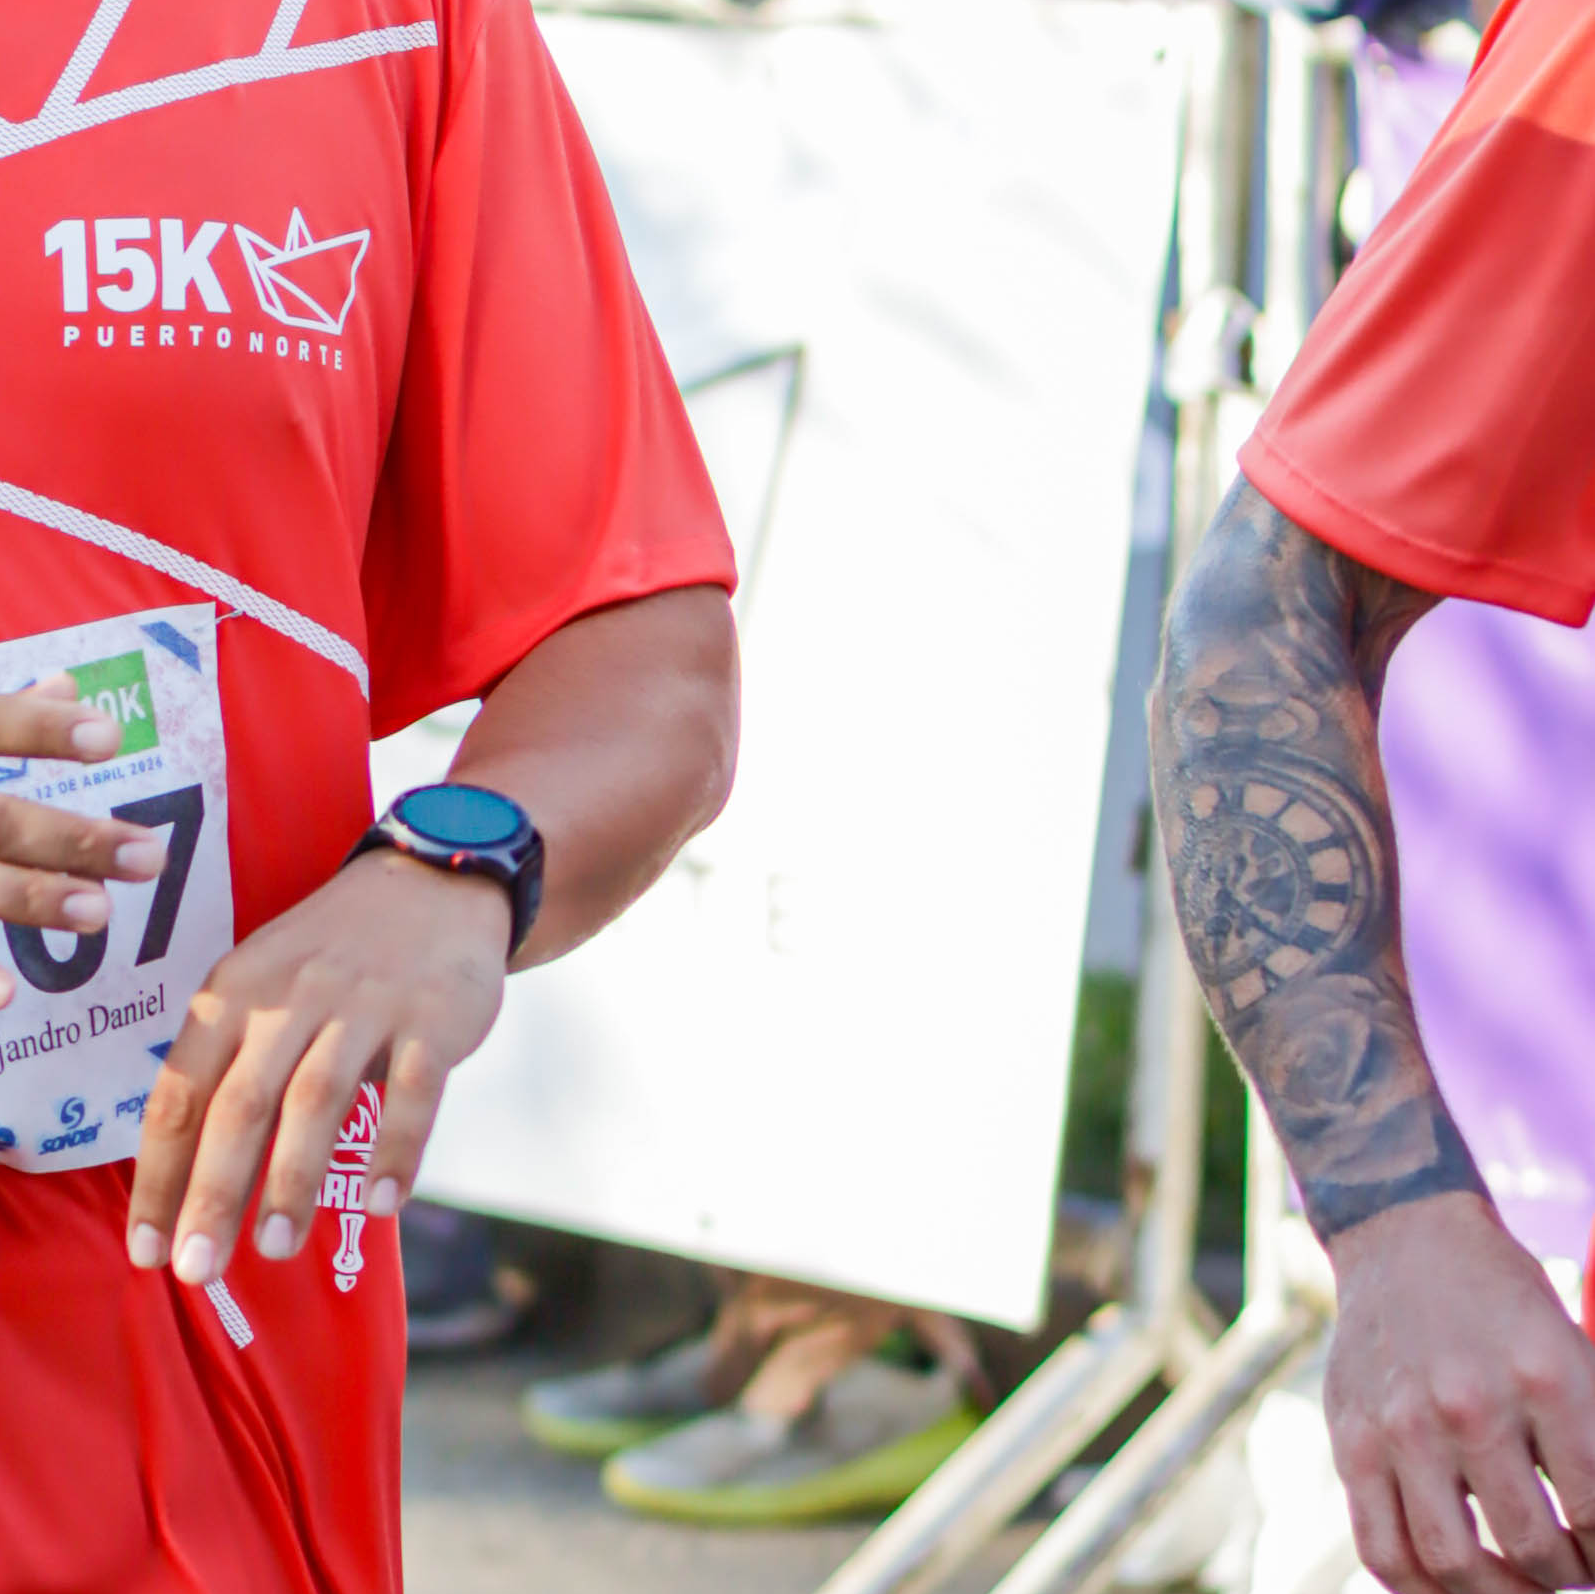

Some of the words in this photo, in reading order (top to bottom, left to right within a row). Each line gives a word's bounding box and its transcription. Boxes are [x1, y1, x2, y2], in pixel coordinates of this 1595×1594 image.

[44, 217, 232, 313] 15K
[35, 785, 53, 800] 12
[58, 779, 78, 795] DE
[82, 766, 125, 788] ABRIL
[87, 983, 166, 1038] Daniel
